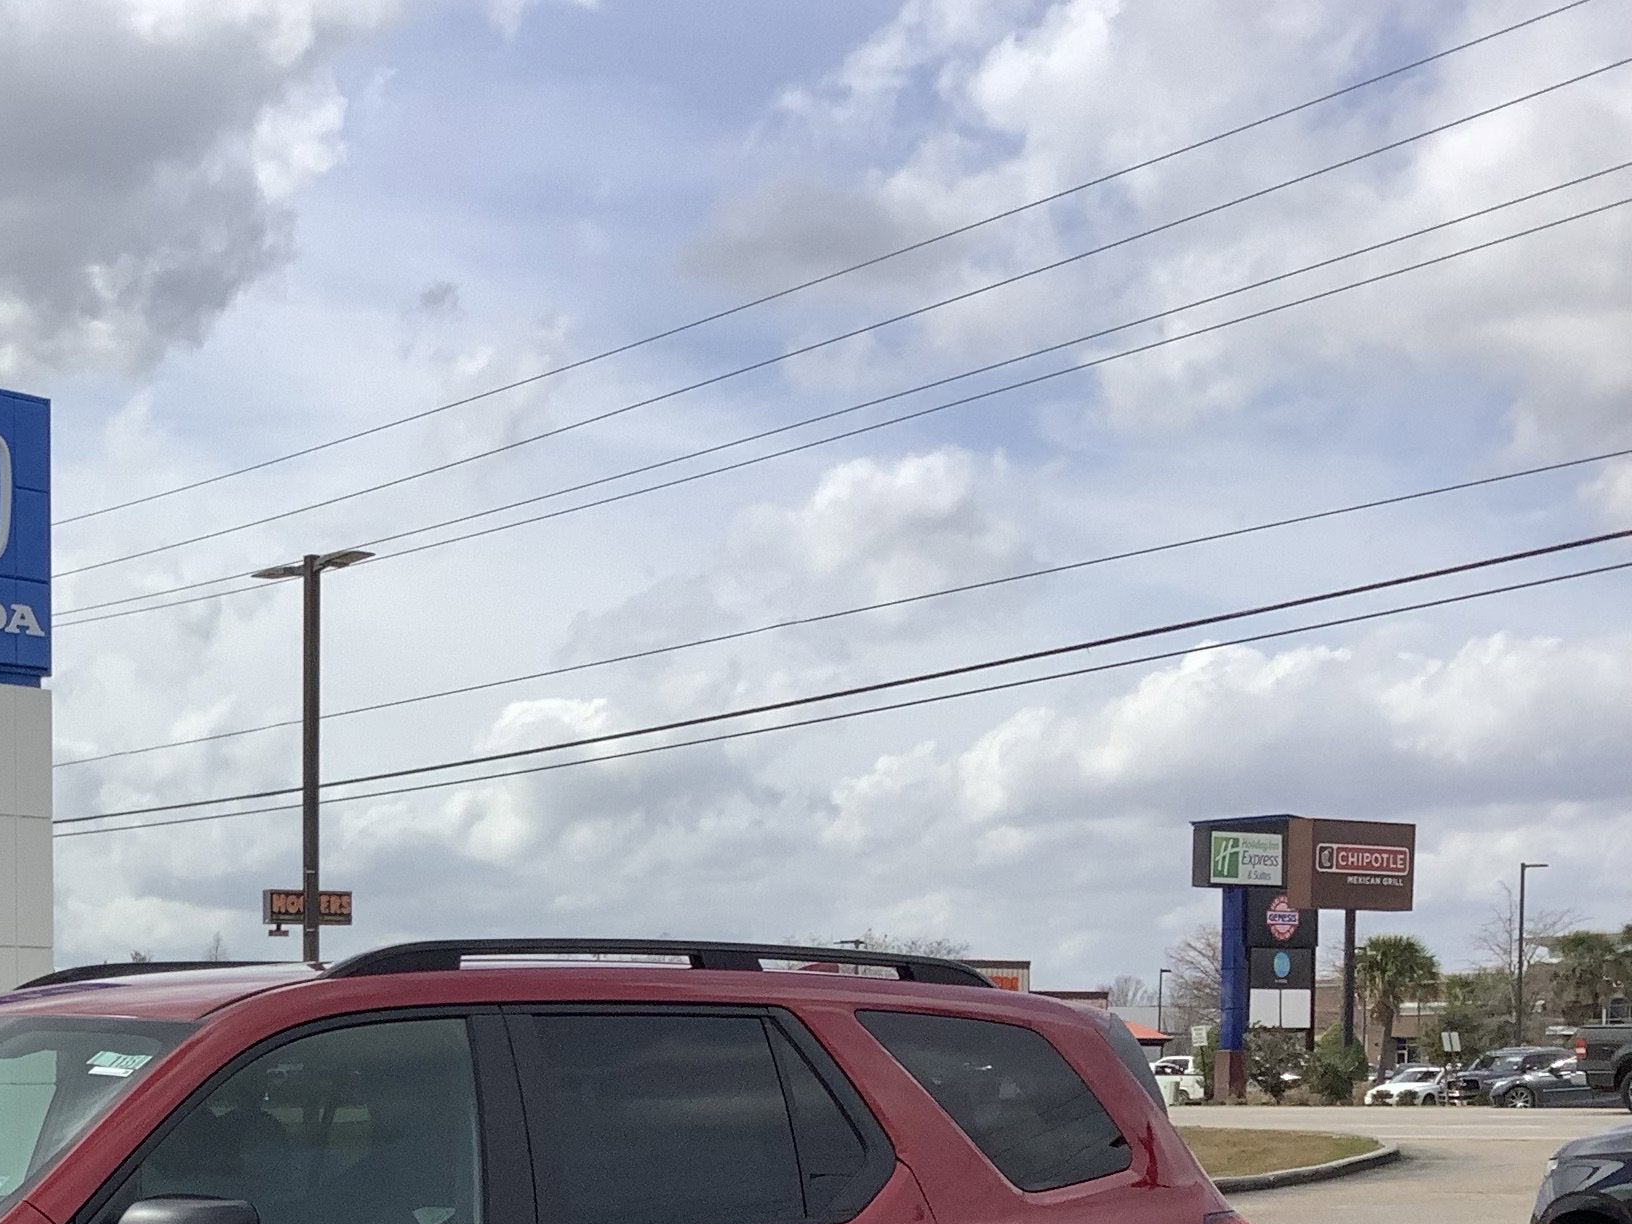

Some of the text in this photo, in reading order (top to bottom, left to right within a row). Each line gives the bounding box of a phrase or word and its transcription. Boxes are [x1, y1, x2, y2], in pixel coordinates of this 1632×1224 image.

[1241, 850, 1279, 869] Express
[1338, 851, 1405, 869] CHIPOTLE
[1347, 876, 1404, 887] MEXICAN GRILL
[271, 893, 351, 914] HOERS
